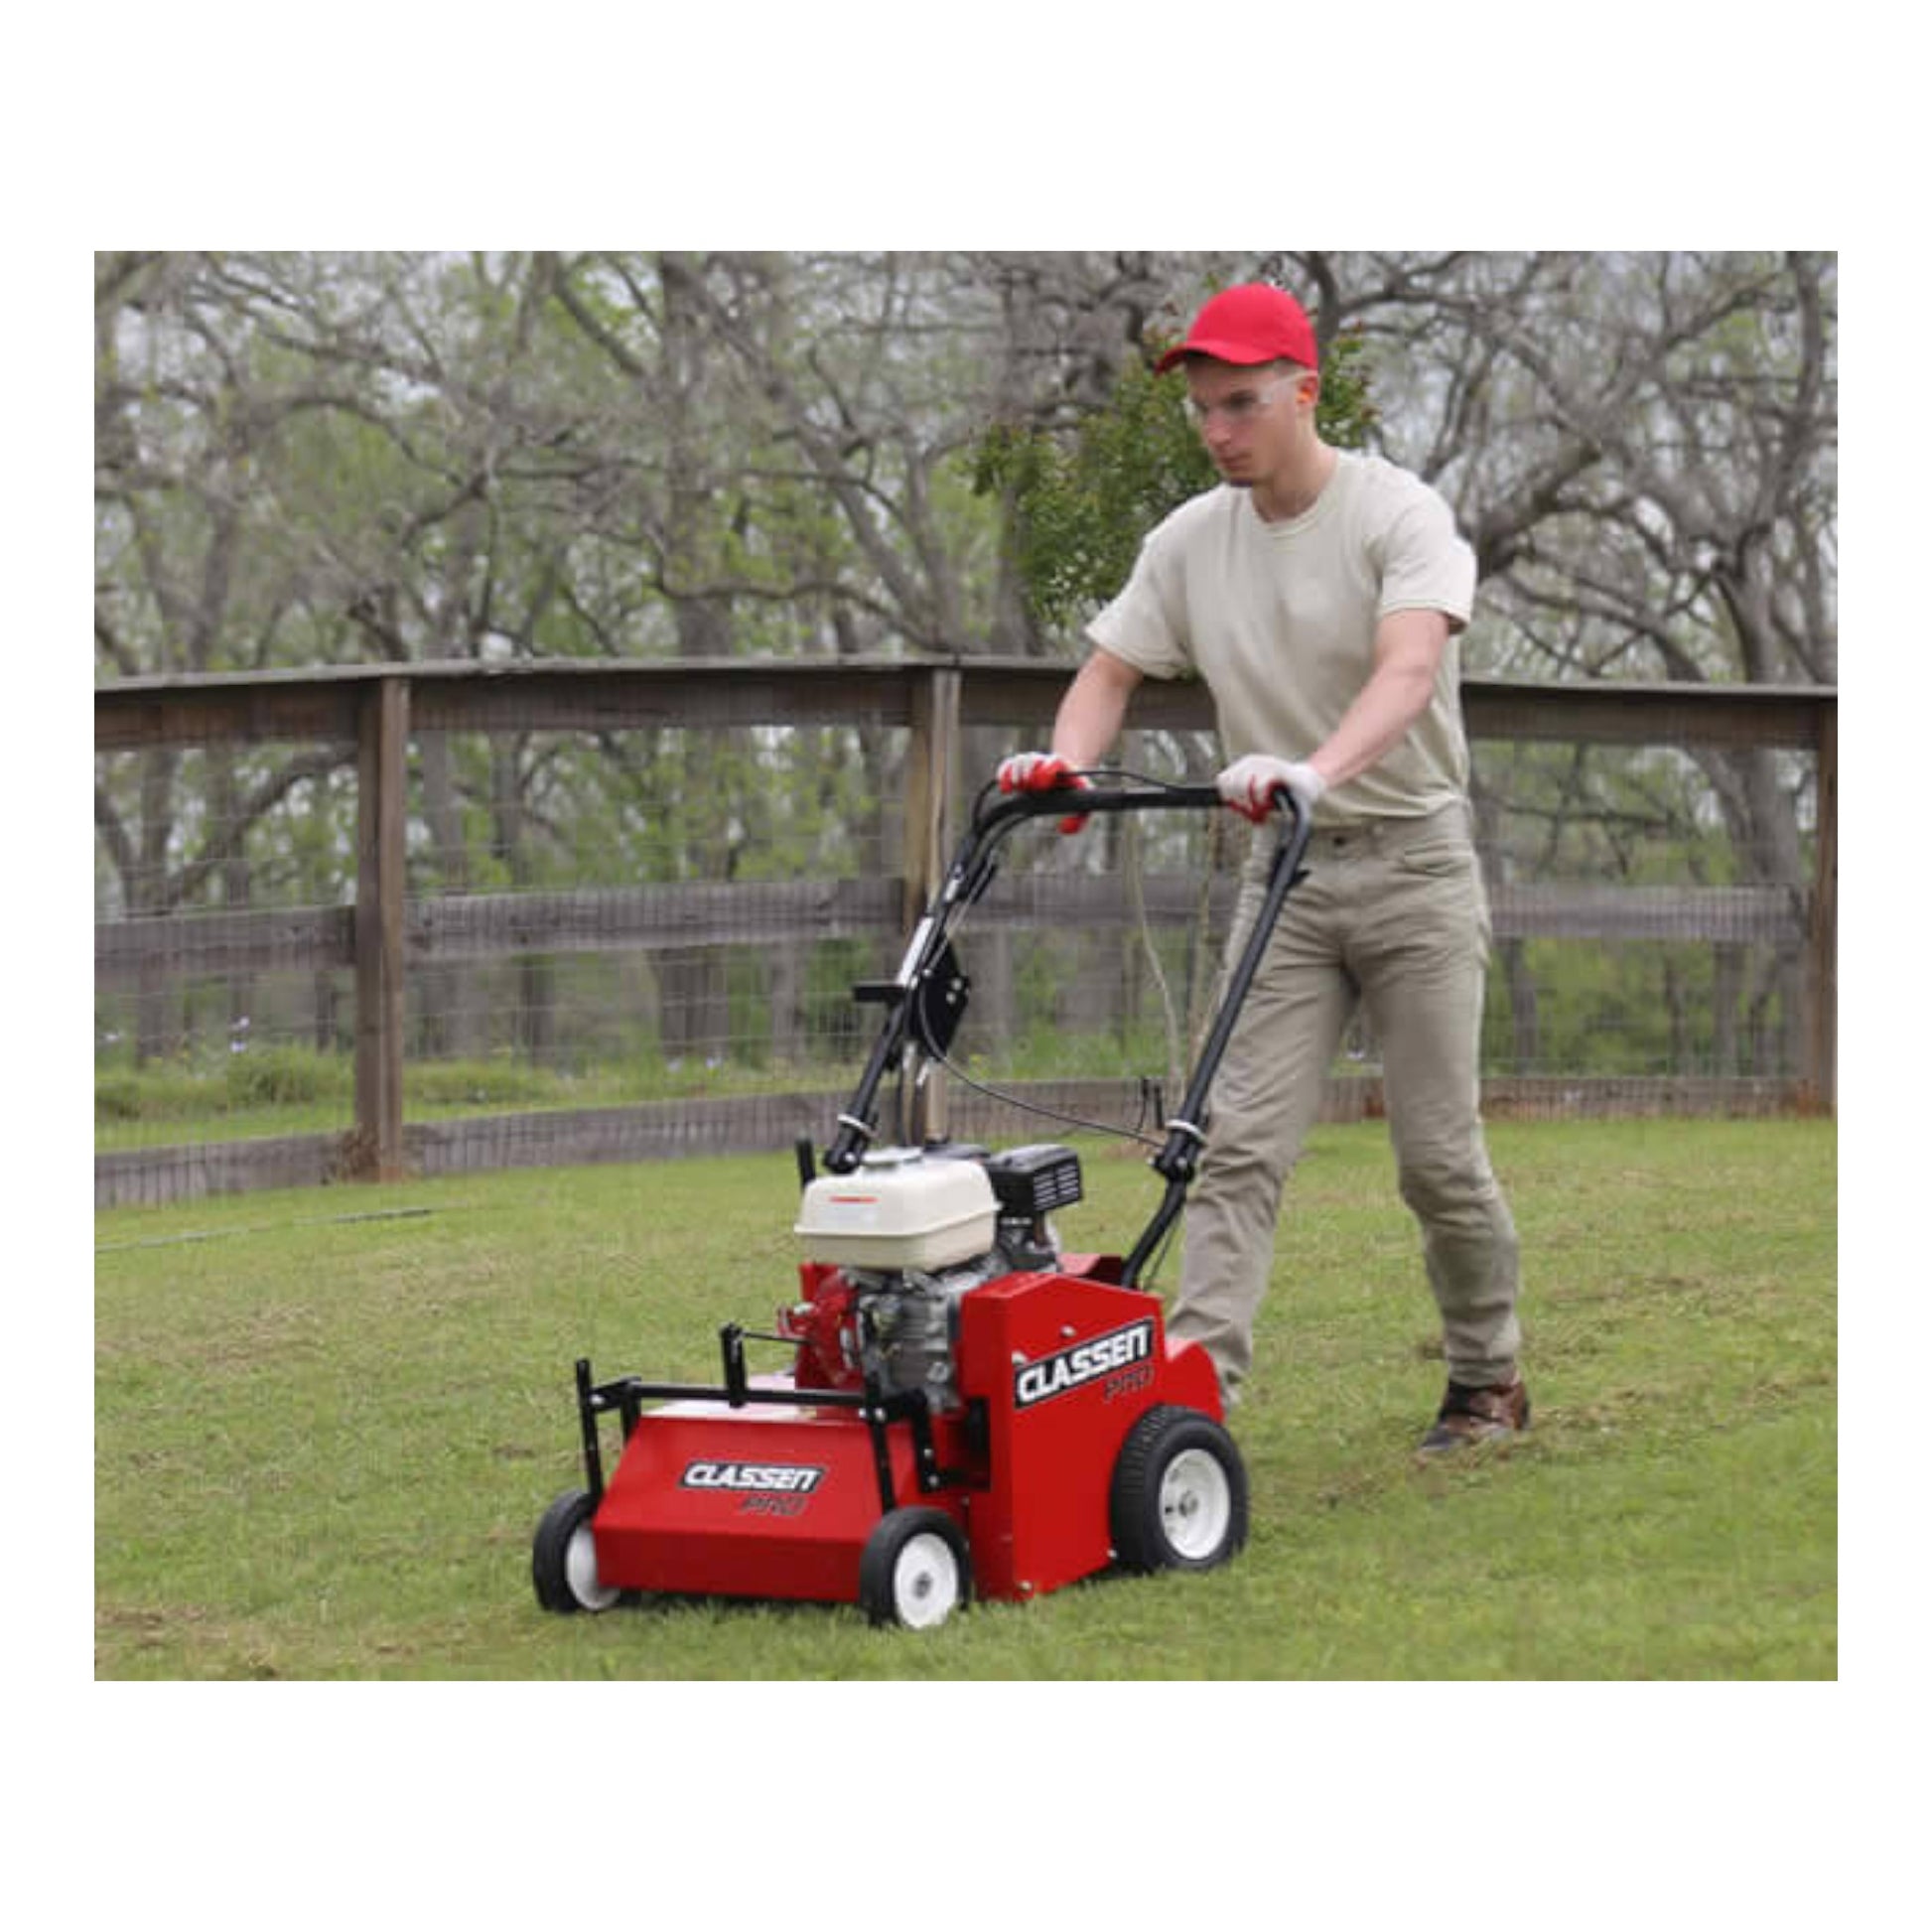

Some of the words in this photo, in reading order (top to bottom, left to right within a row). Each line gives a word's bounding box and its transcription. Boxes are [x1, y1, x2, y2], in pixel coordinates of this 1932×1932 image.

[1018, 1323, 1149, 1403] CLASSEN
[1103, 1365, 1155, 1405] PRO
[684, 1464, 821, 1491] CLASSEN
[741, 1496, 808, 1516] PRO
